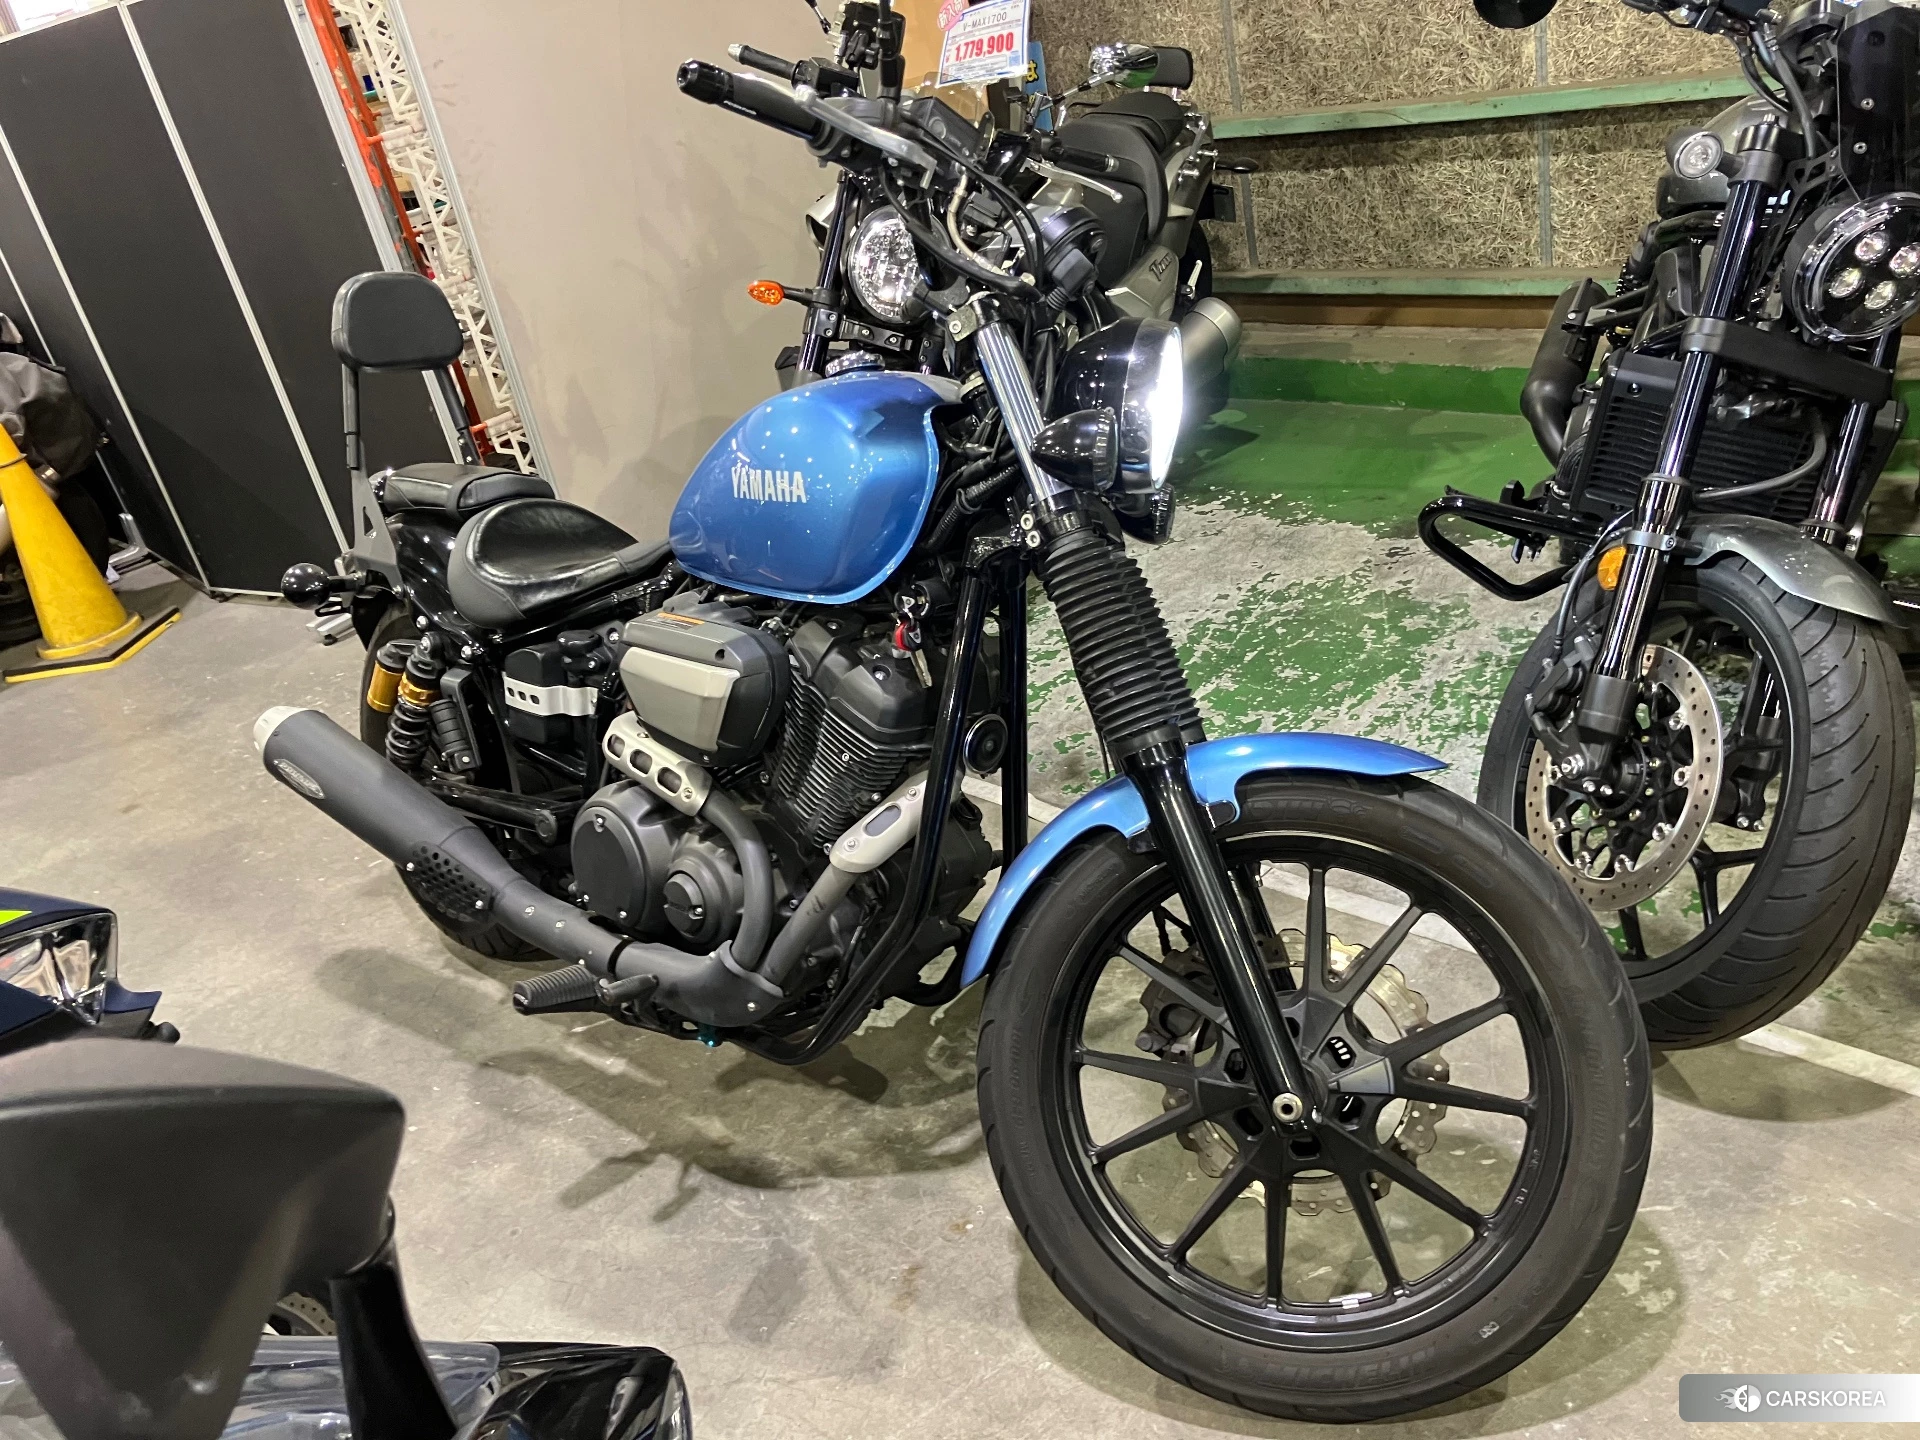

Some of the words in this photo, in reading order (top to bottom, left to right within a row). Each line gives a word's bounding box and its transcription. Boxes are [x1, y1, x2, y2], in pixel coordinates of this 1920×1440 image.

[963, 12, 1007, 31] V-MAX1700
[955, 32, 1014, 62] 1,779,900
[731, 464, 807, 504] YAMAHA
